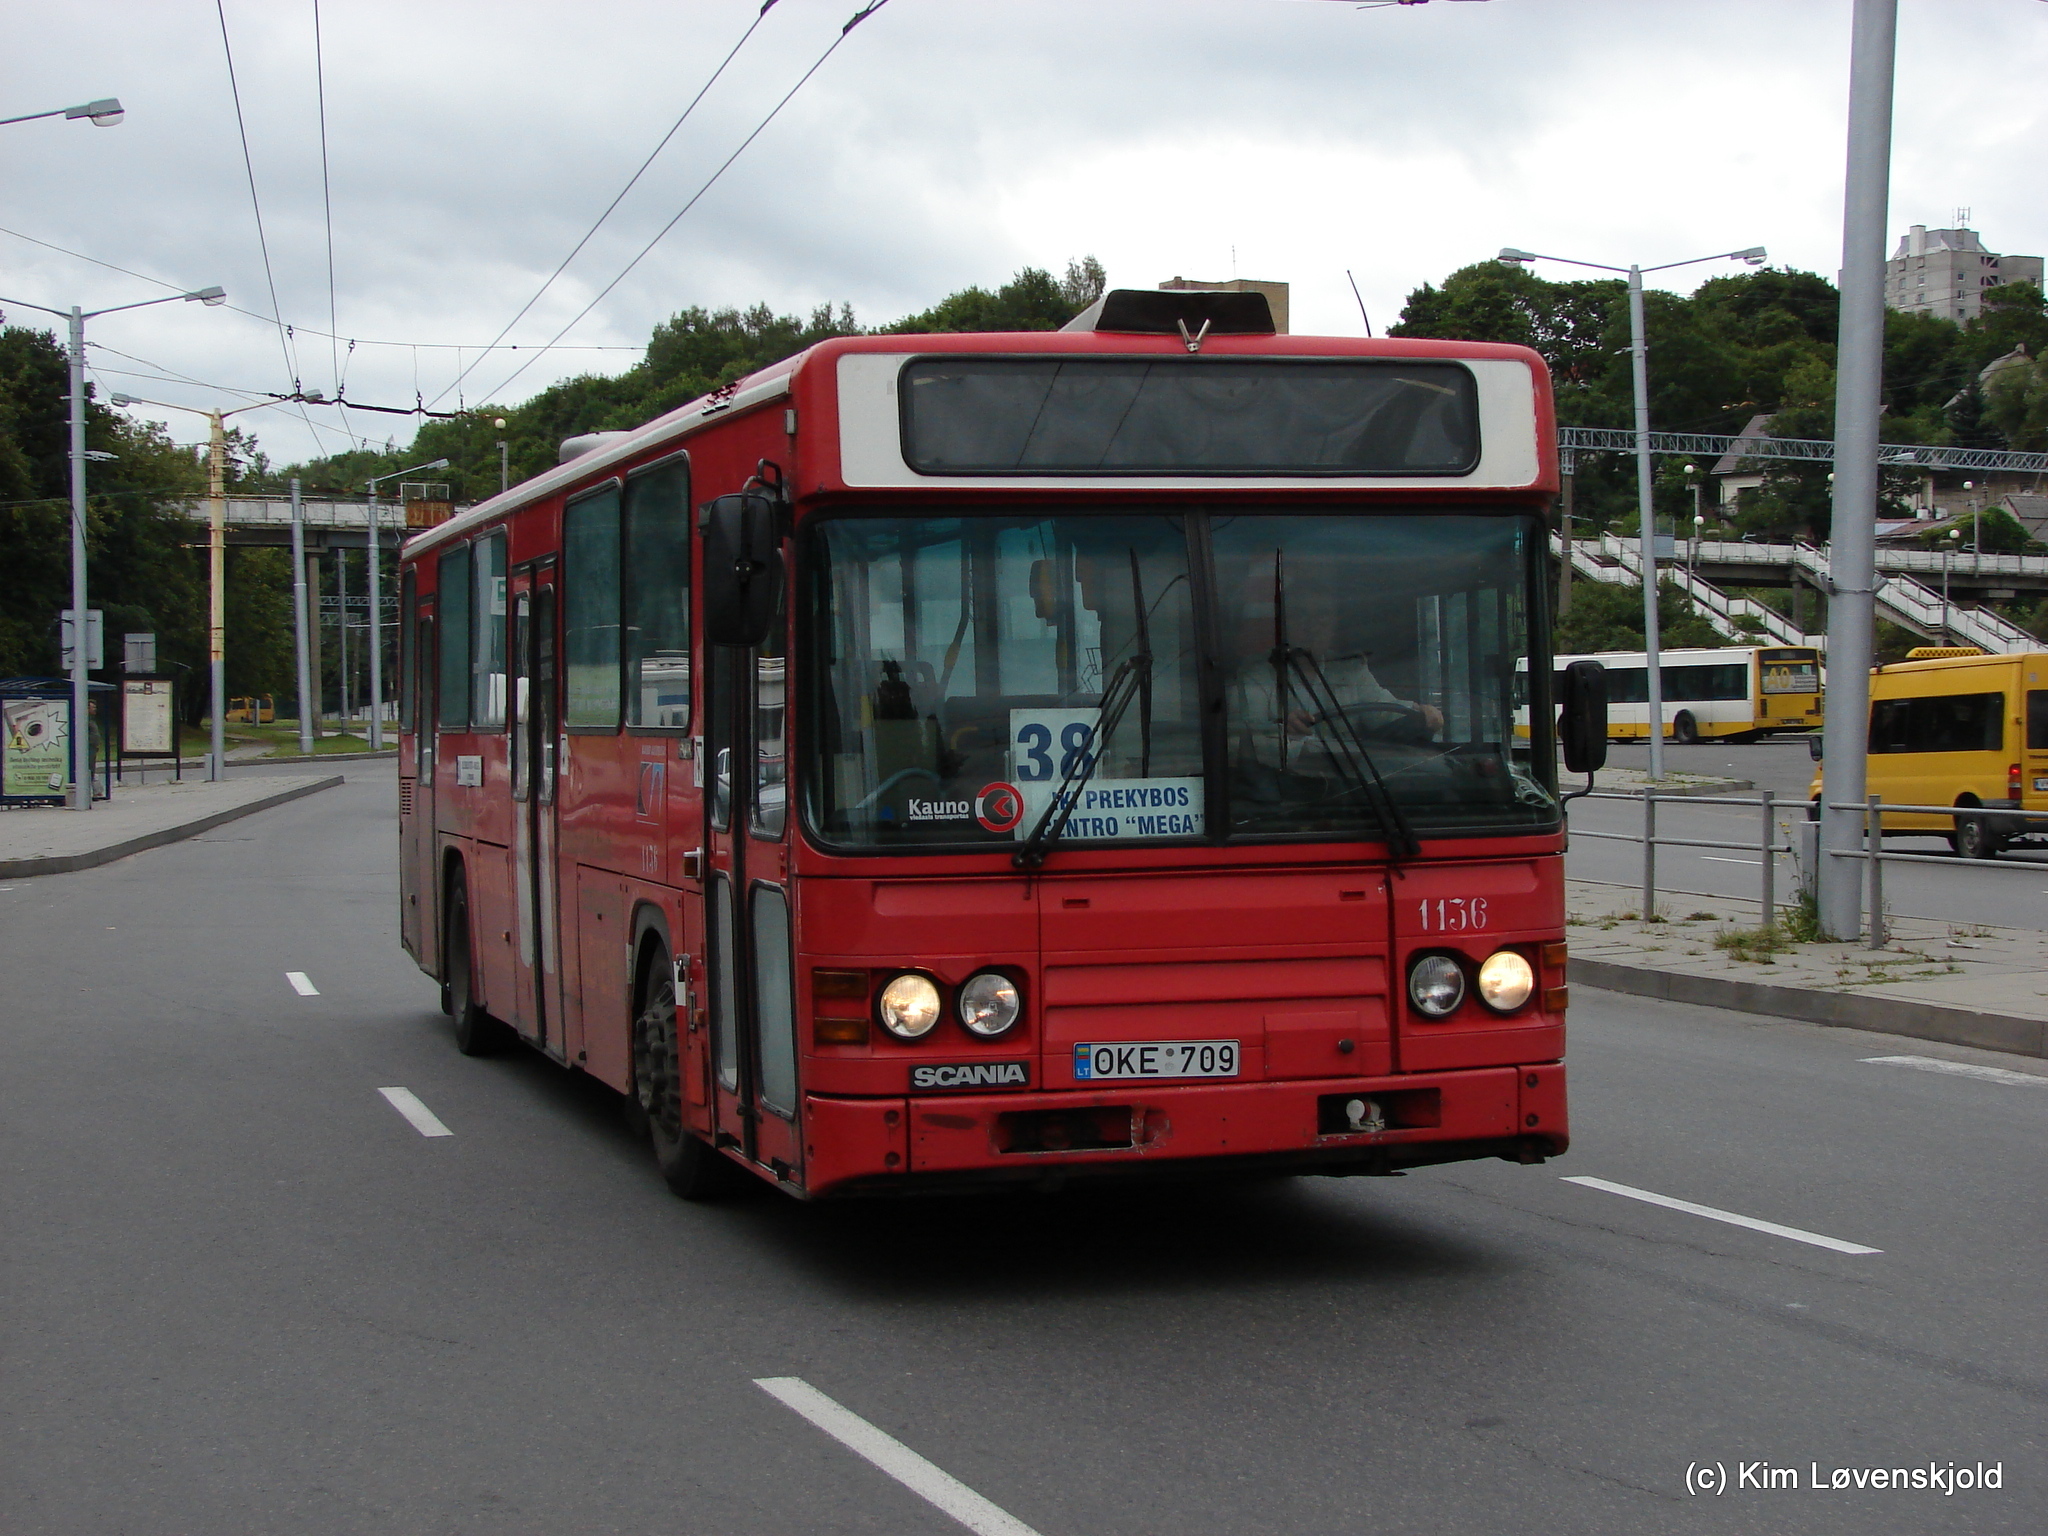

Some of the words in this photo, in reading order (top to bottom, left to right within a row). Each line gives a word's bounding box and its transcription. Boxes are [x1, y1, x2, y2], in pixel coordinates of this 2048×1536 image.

[1016, 722, 1095, 781] 38
[908, 798, 970, 815] Kauno
[1086, 787, 1189, 810] PREKYBOS
[1419, 897, 1488, 931] 1136
[1094, 1046, 1159, 1075] OKE
[1180, 1044, 1234, 1073] 709
[913, 1064, 1026, 1087] SCANIA
[1076, 1069, 1089, 1077] LT
